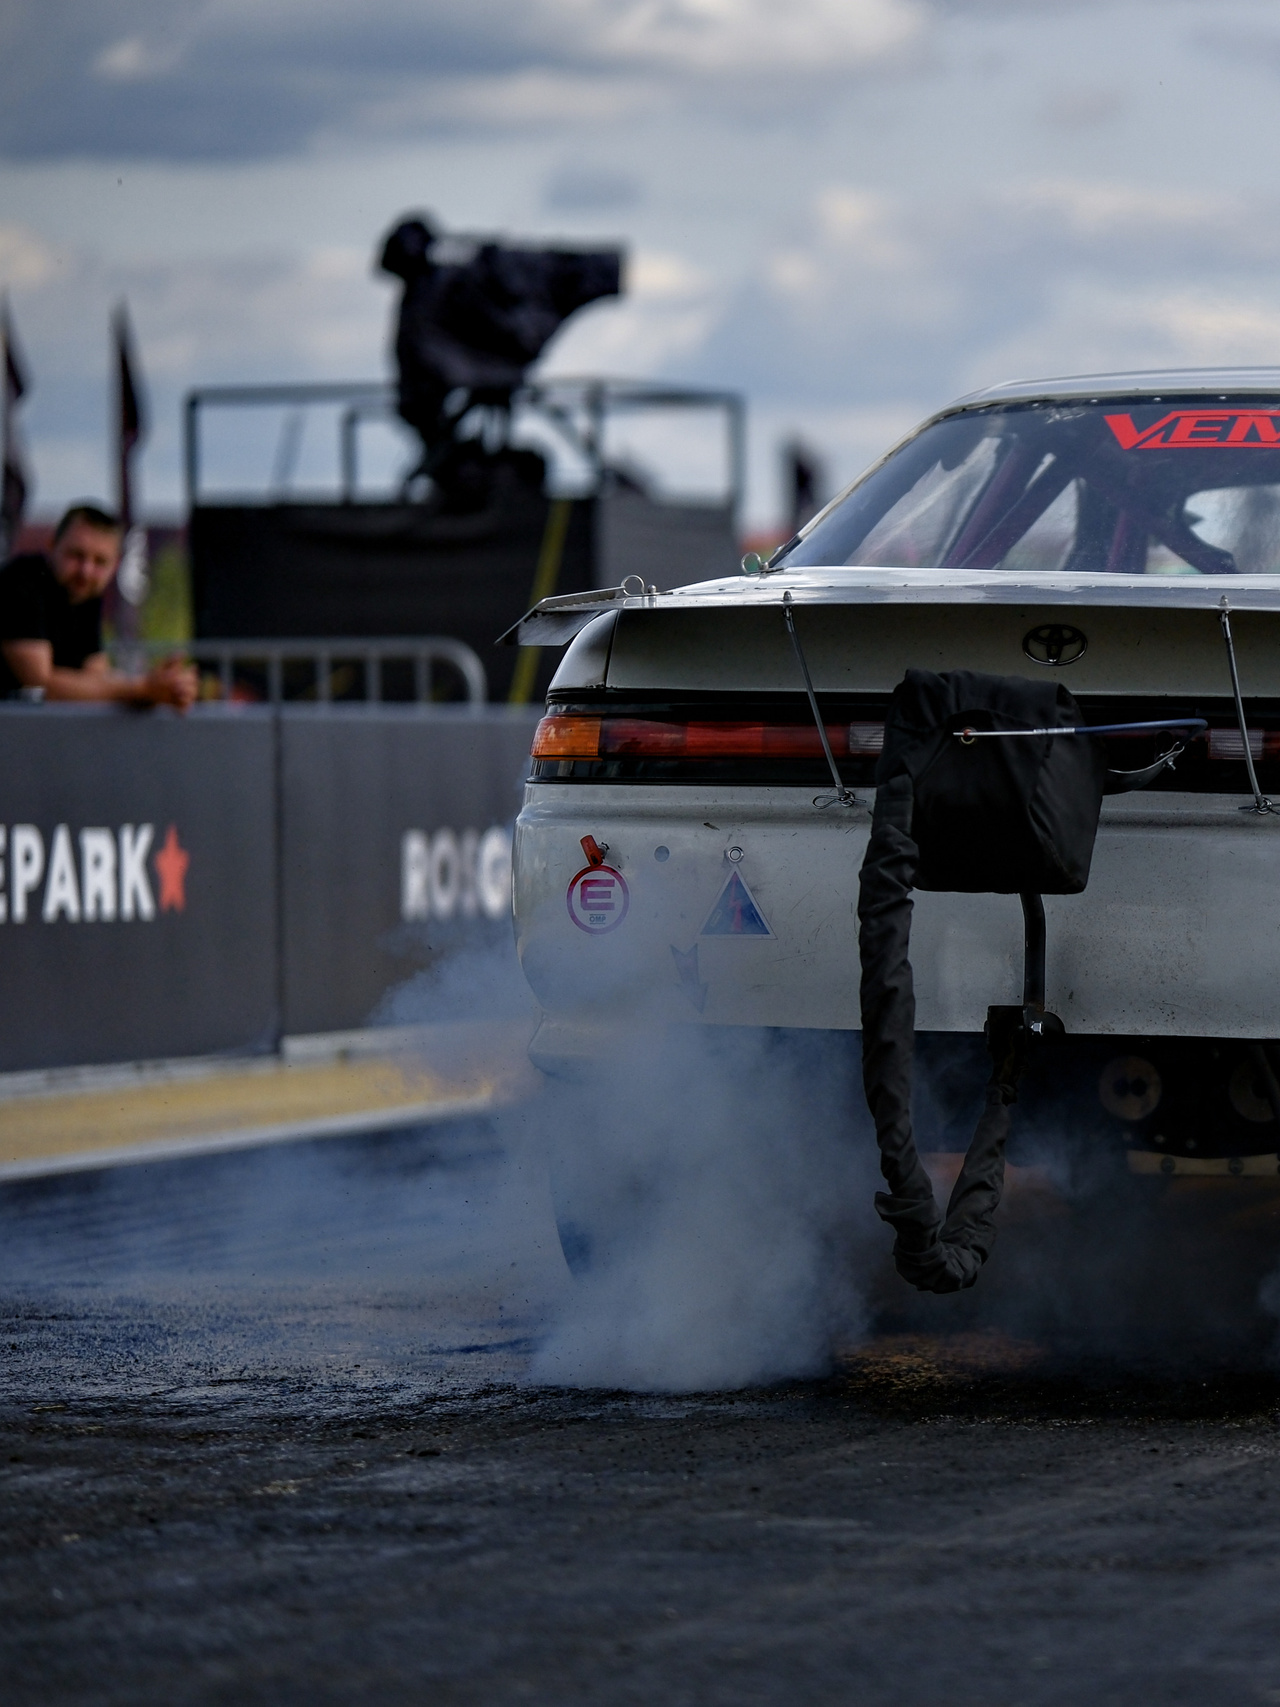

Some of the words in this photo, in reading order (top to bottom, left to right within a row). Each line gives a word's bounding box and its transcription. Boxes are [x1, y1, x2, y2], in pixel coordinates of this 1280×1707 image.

[0, 823, 156, 924] PARK
[581, 879, 615, 910] E
[589, 915, 606, 923] OMP
